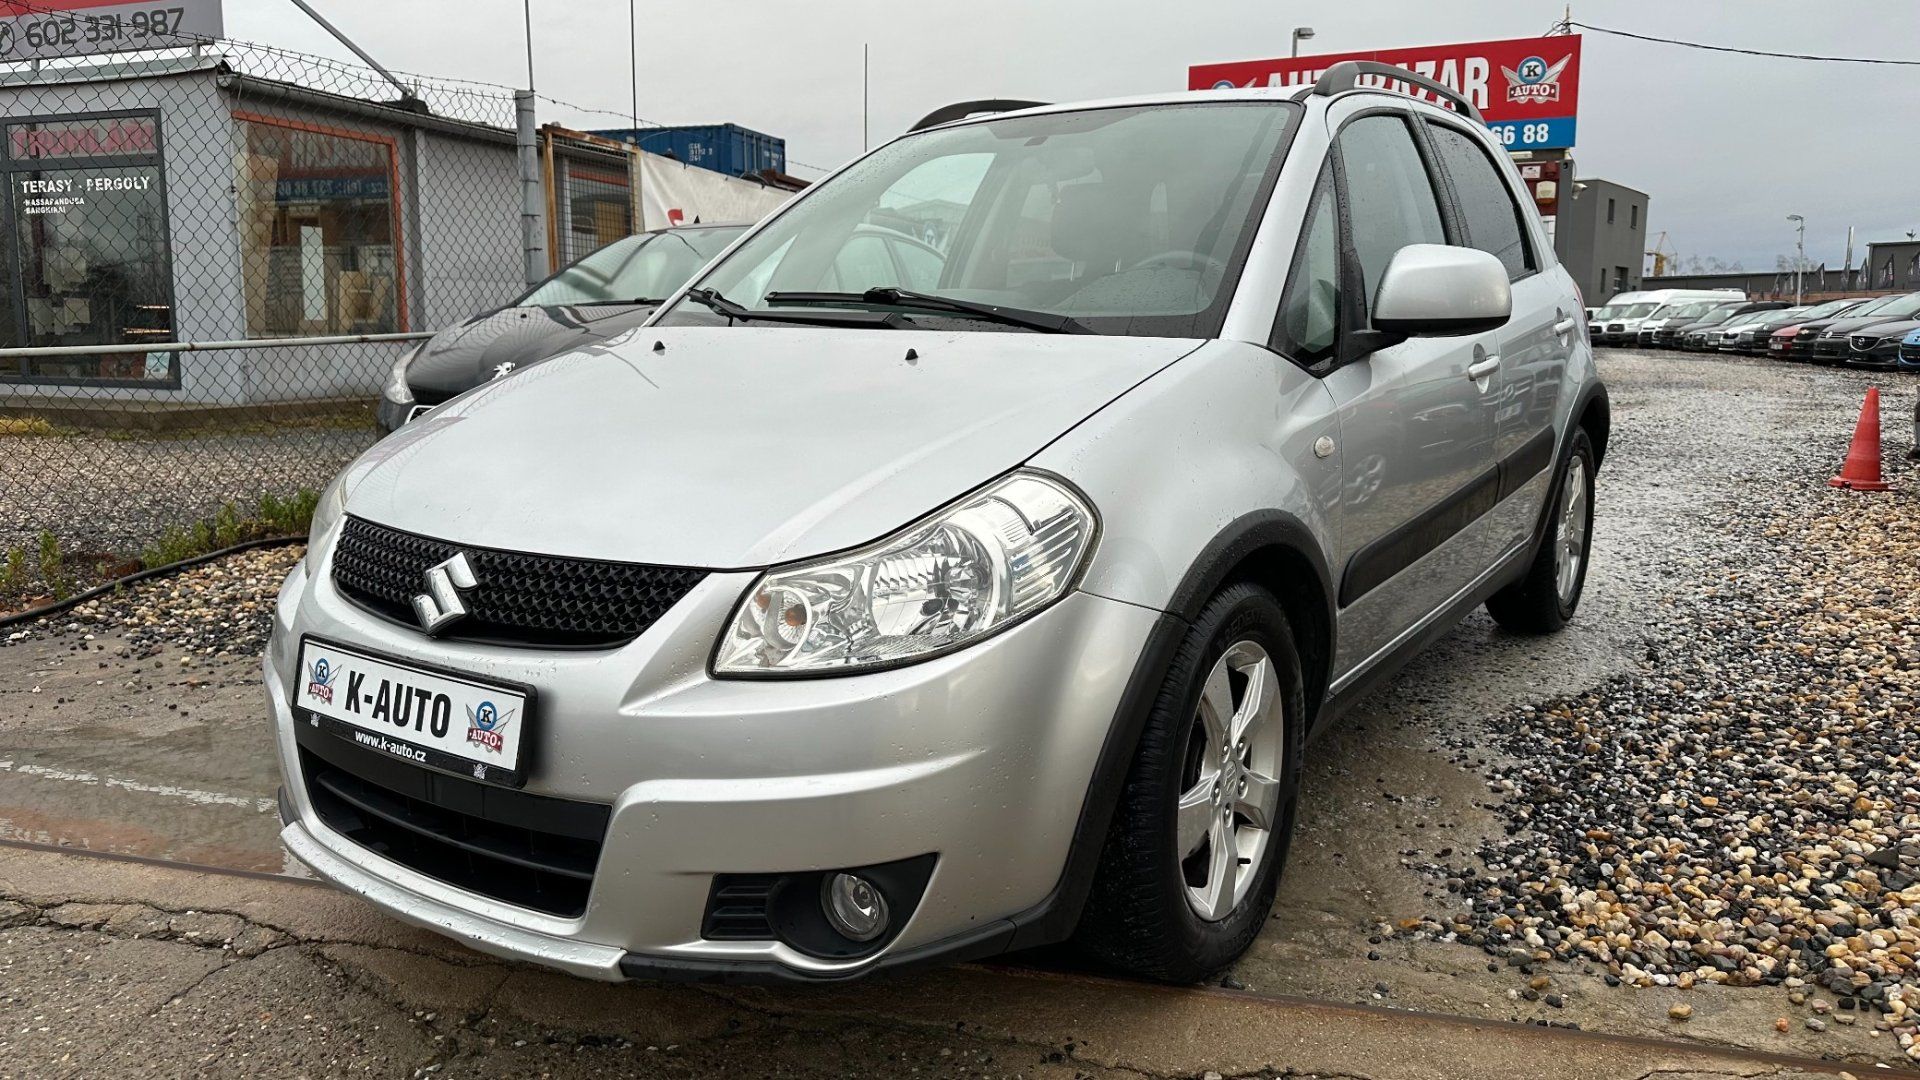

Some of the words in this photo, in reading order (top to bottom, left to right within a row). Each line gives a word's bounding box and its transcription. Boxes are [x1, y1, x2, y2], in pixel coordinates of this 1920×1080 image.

[26, 18, 77, 47] 602
[86, 13, 122, 42] 331
[131, 7, 184, 39] 987
[1524, 65, 1540, 77] K
[1514, 84, 1550, 97] AUTO
[1523, 123, 1549, 143] 88
[21, 179, 73, 194] TERASY
[86, 176, 150, 191] PERGOLY
[318, 665, 326, 679] K
[311, 683, 331, 700] AUTO
[345, 670, 452, 739] K-AUTO
[481, 708, 492, 724] K
[355, 730, 427, 763] www.k-auto.cz
[471, 730, 499, 748] AUTO
